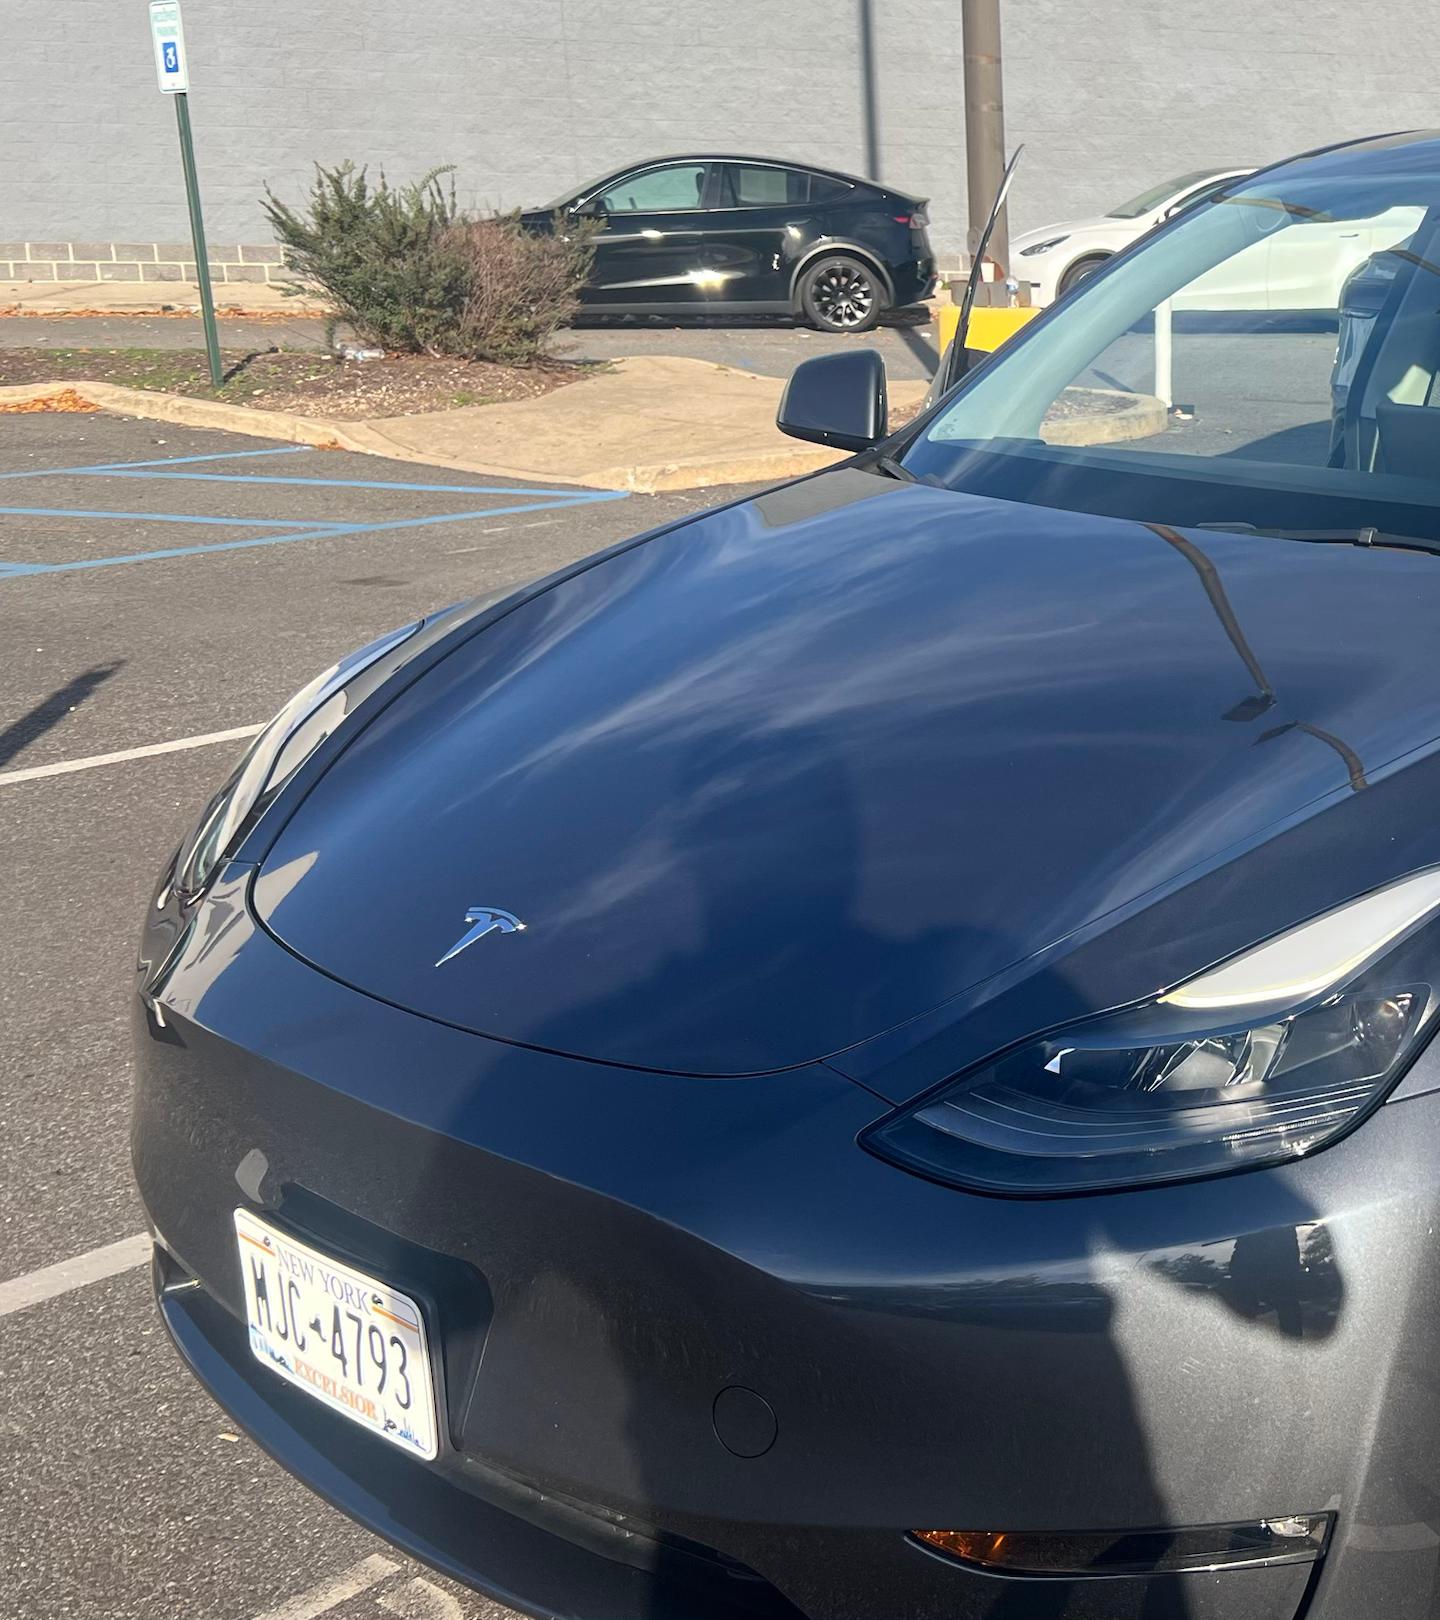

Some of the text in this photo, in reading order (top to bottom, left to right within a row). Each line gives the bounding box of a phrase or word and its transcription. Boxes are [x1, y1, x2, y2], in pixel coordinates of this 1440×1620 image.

[276, 1245, 372, 1316] NEW YORK
[294, 1358, 377, 1421] EXCELSIOR
